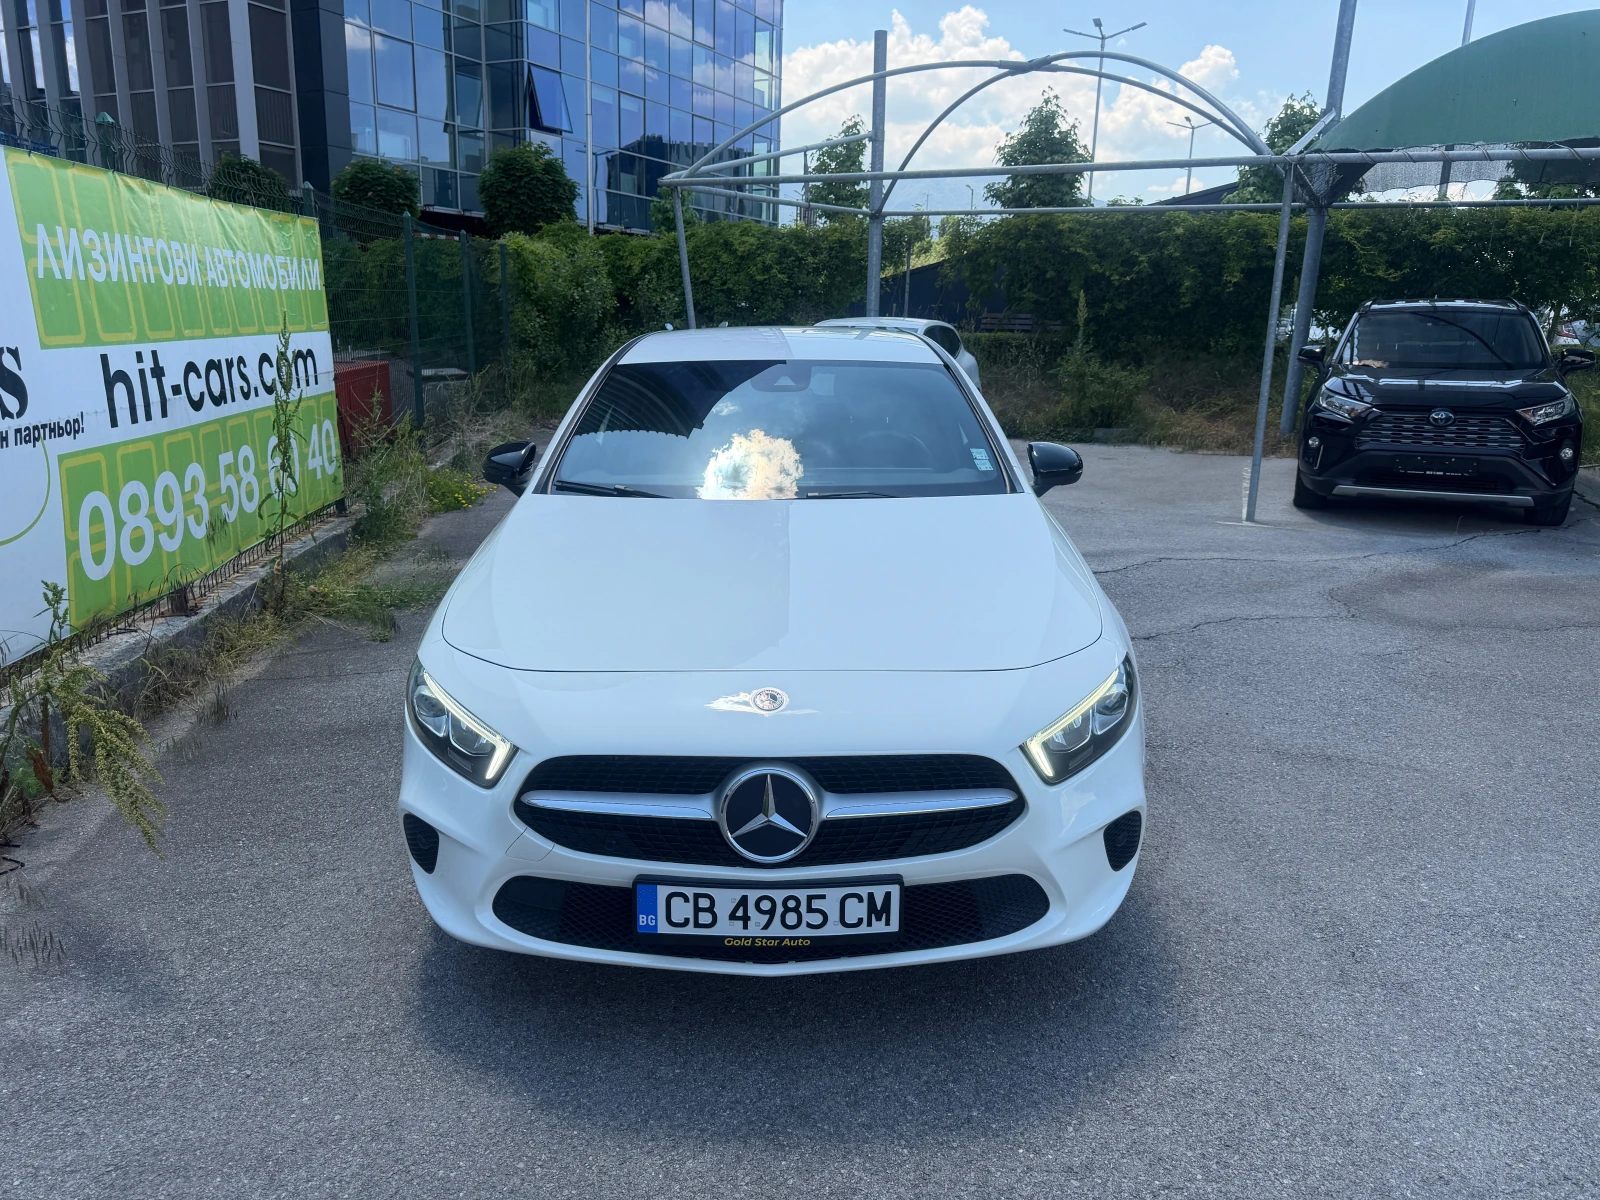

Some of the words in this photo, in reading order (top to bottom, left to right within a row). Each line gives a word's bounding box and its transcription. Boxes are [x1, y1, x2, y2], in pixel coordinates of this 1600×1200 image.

[36, 223, 203, 286] ЛИЗИНГОВИ
[206, 246, 322, 291] АВТОМОБИЛИ
[14, 411, 85, 449] партньор!
[78, 462, 210, 582] 0893
[218, 444, 260, 523] 58
[308, 418, 337, 480] 40
[638, 914, 656, 926] BG
[665, 891, 718, 929] CB
[728, 893, 829, 931] 4985
[839, 890, 892, 930] CM
[724, 937, 752, 946] Gold
[754, 937, 780, 946] Star
[781, 937, 811, 946] Auto
